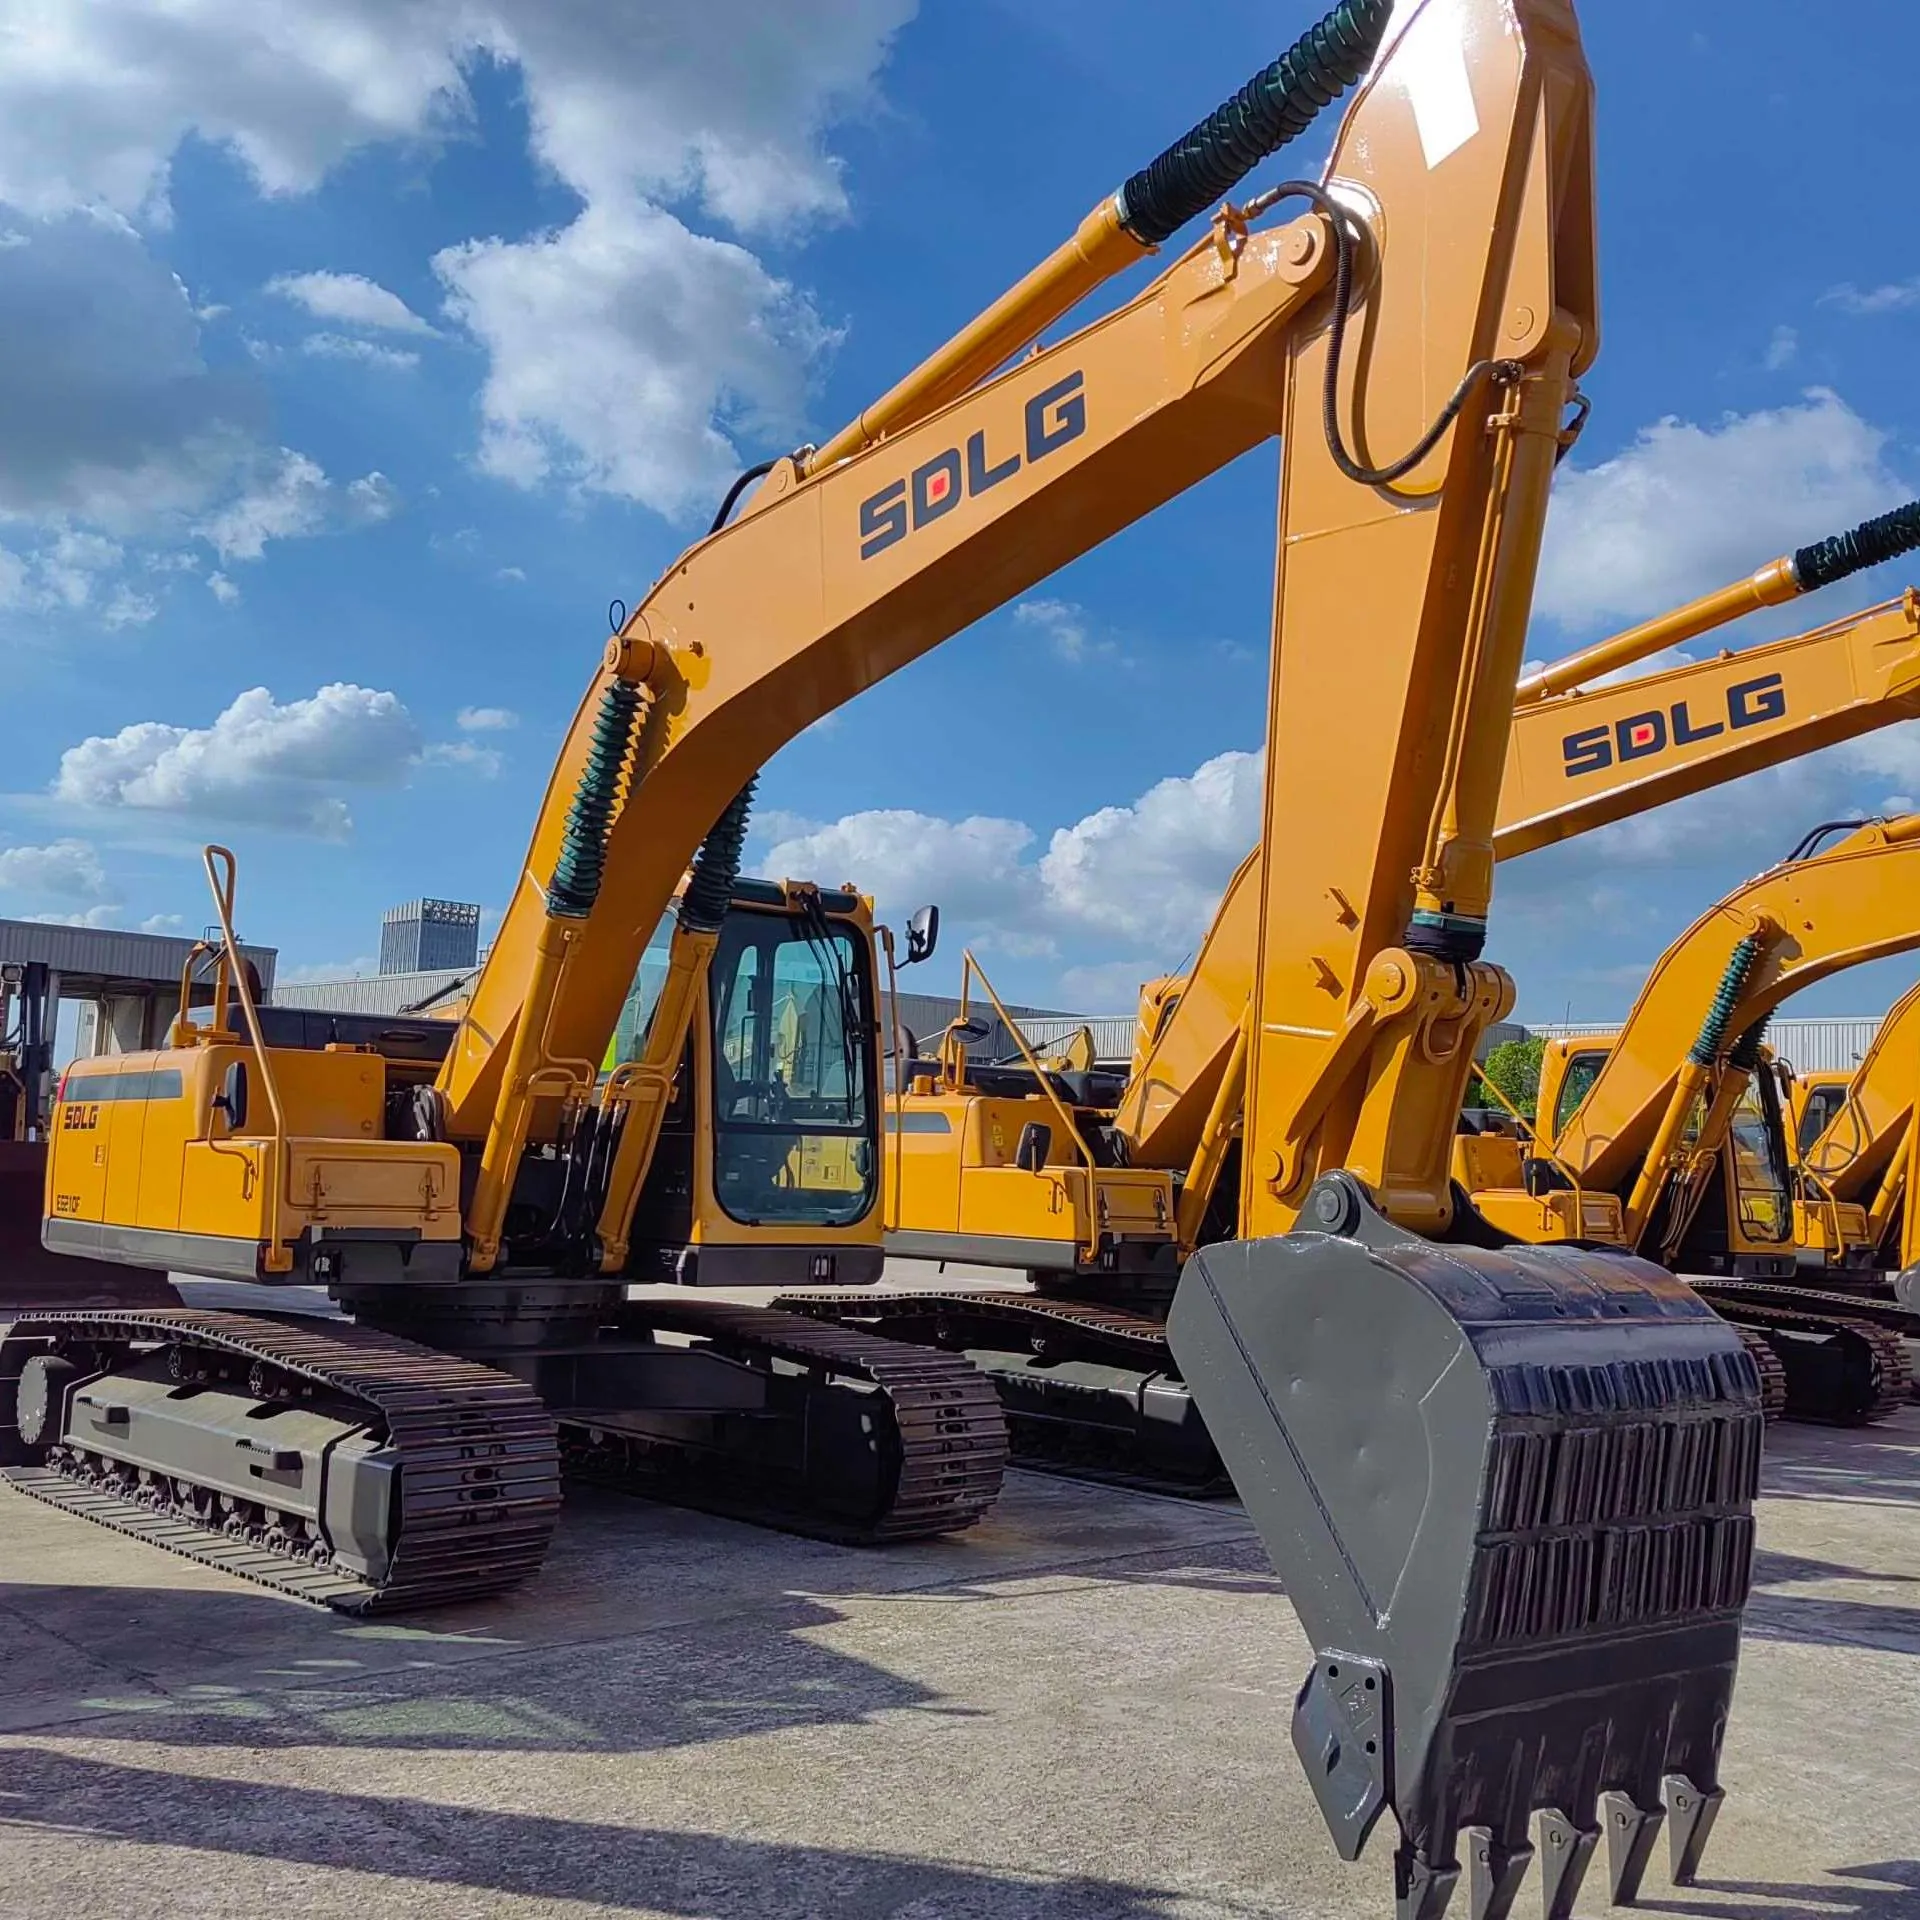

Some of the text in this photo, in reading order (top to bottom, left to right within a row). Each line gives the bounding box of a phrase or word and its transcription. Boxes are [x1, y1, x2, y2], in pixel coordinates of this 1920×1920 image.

[860, 369, 1085, 560] SDLG
[1562, 672, 1786, 778] SDLG
[64, 1105, 99, 1130] SDLG
